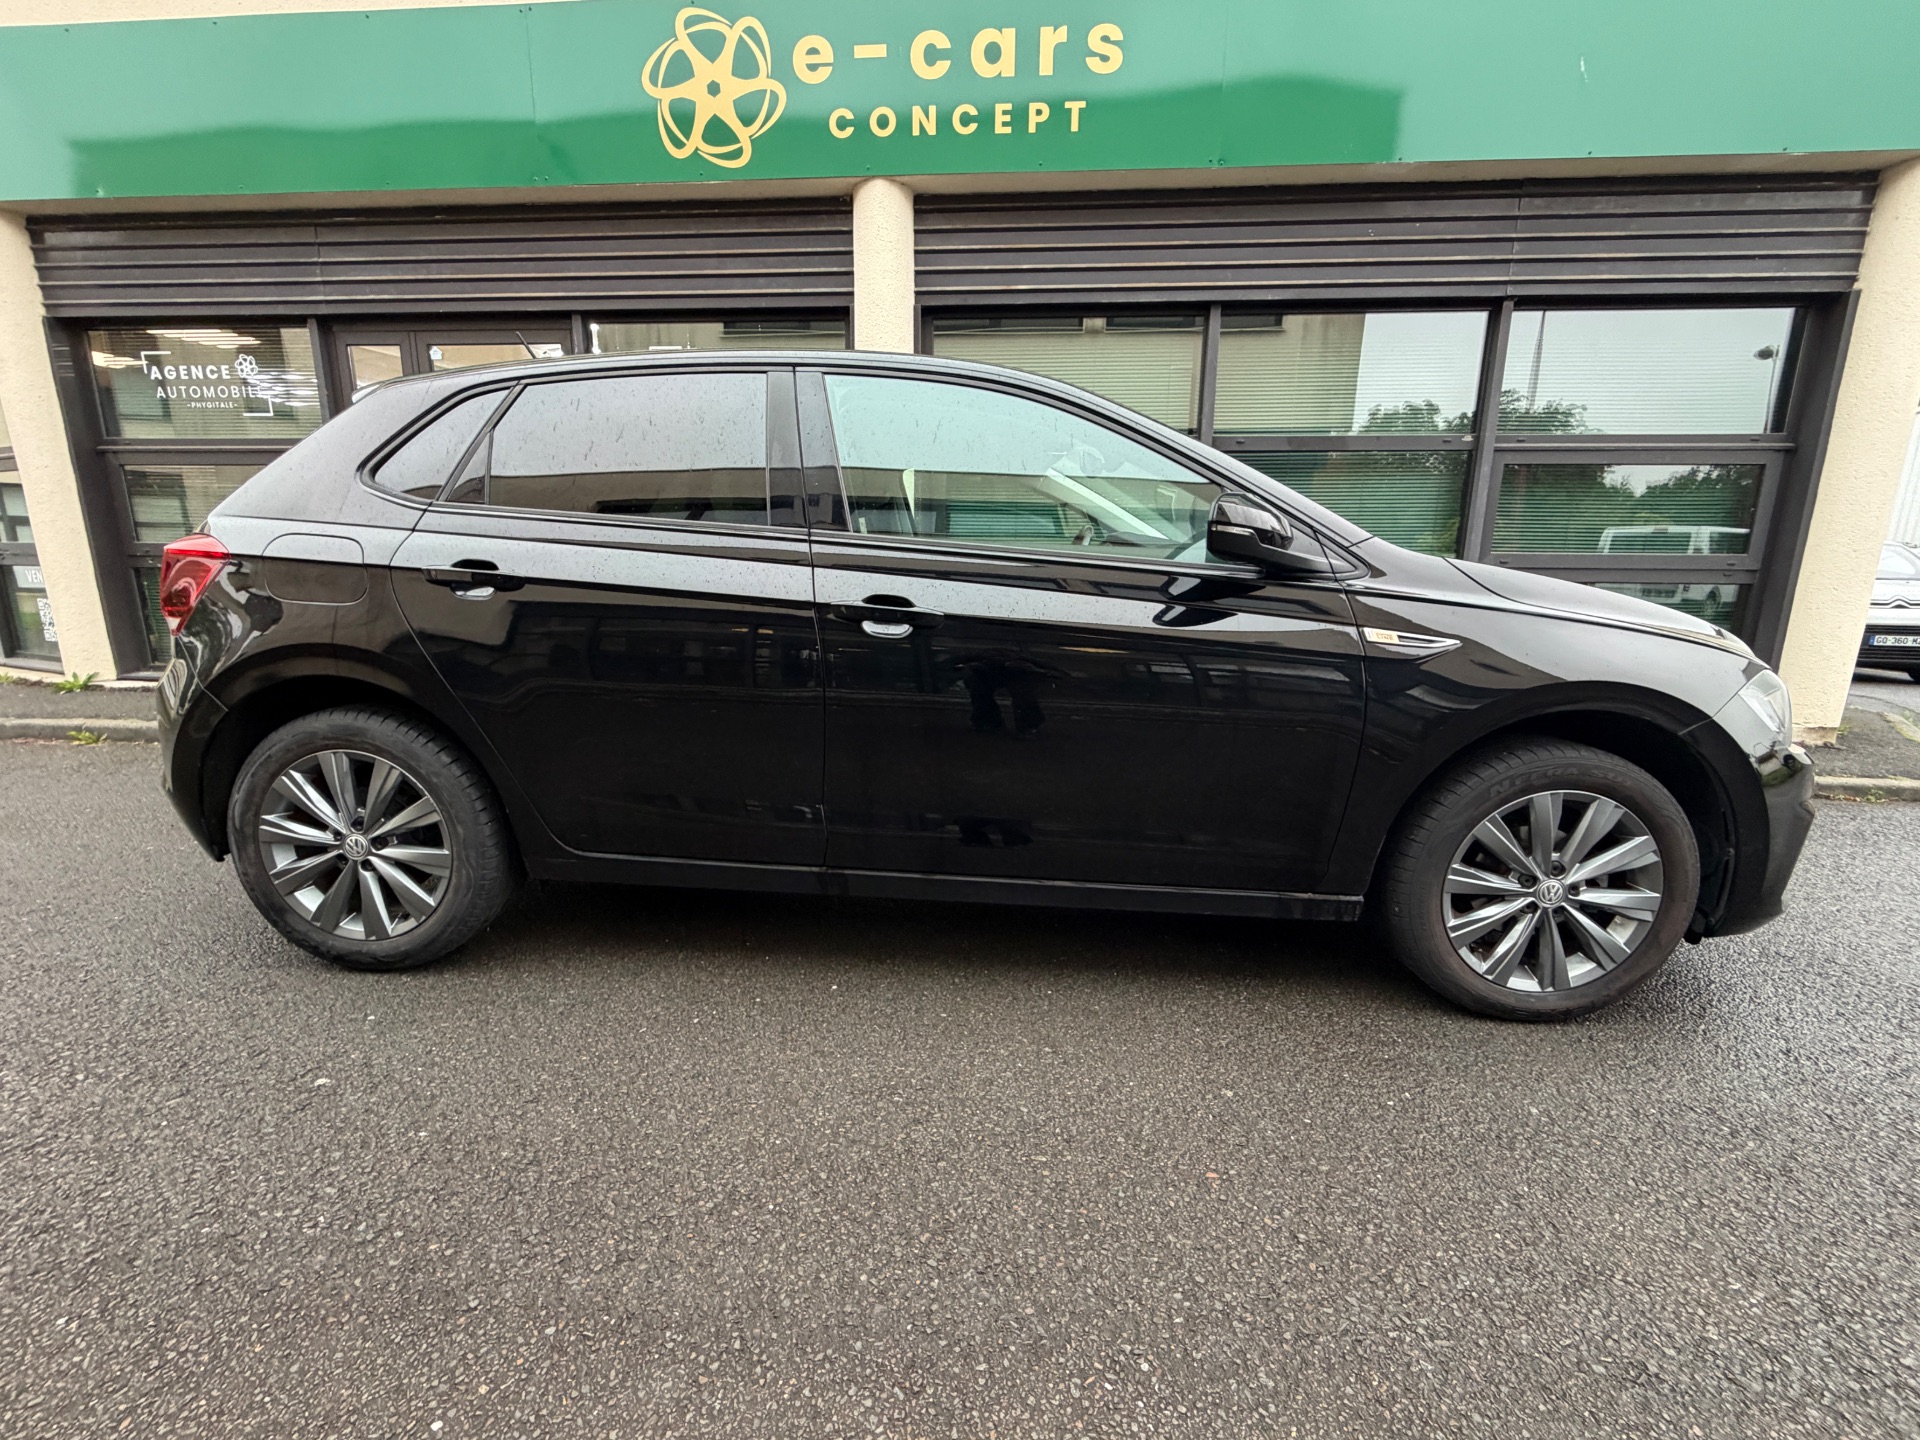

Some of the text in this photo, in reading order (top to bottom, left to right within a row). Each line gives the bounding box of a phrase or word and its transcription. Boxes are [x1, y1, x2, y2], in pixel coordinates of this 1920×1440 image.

[793, 23, 1123, 84] e-cars
[829, 100, 1086, 138] CONCEPT
[150, 365, 231, 380] AGENCE
